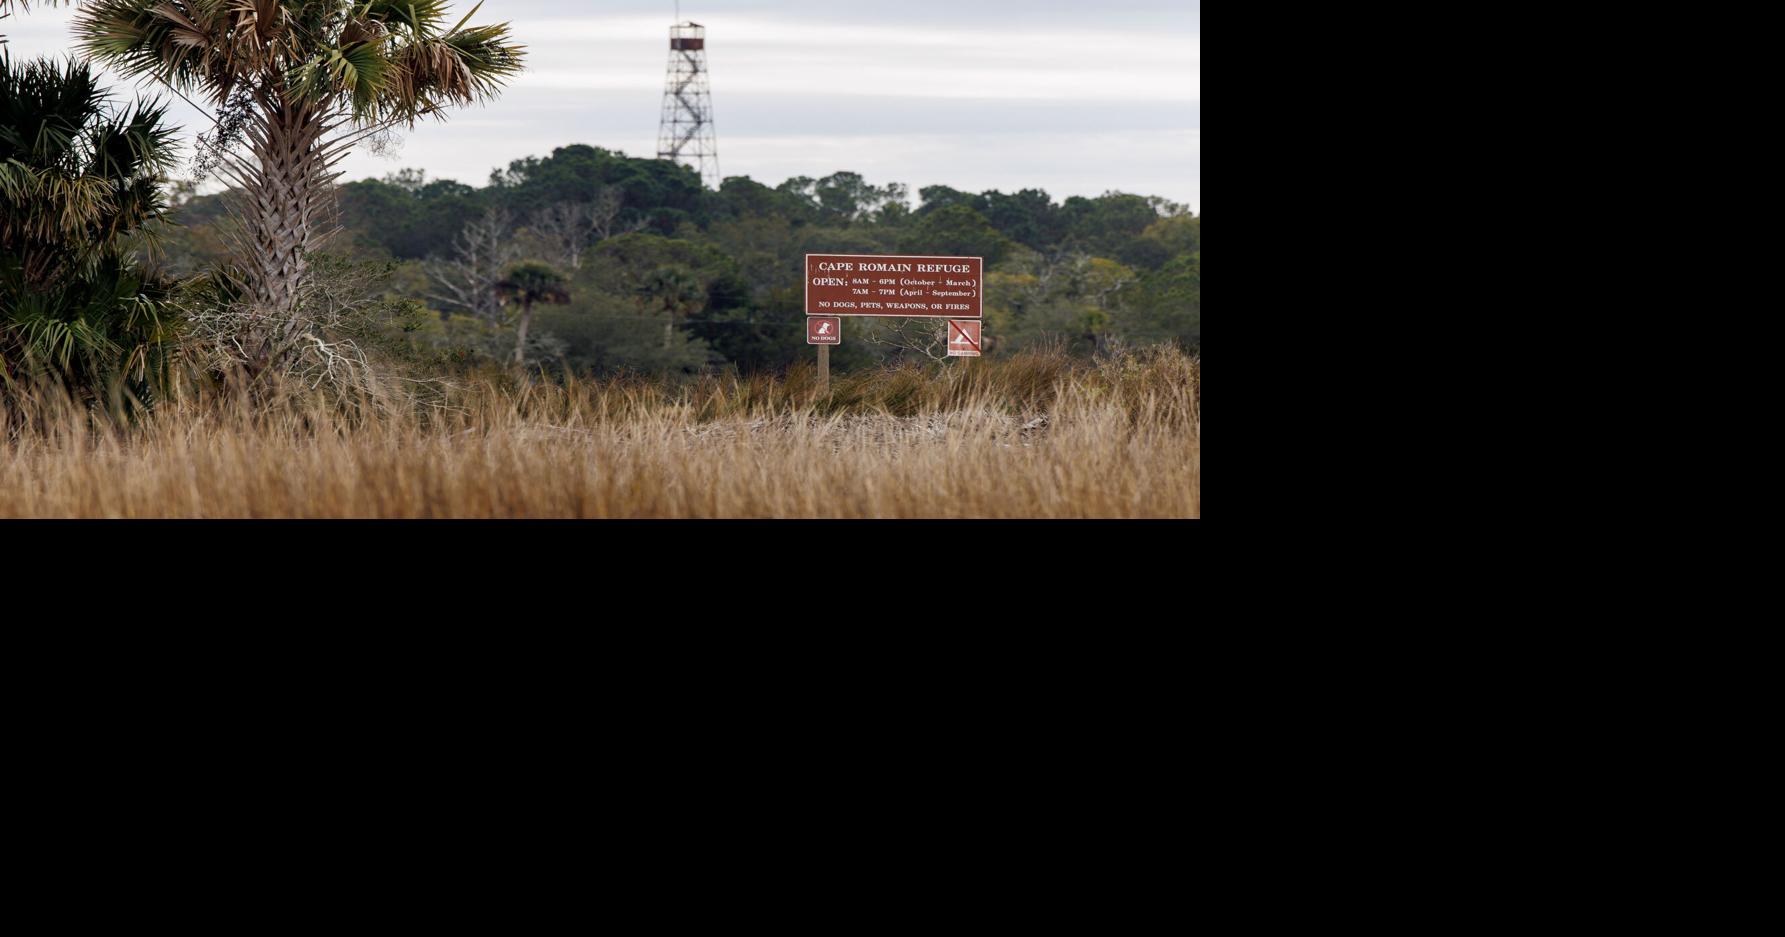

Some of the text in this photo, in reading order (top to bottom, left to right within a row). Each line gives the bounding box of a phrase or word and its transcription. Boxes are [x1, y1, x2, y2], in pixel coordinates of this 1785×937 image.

[819, 262, 970, 273] CAPE ROMAIN REFUGE
[812, 277, 848, 286] OPEN:
[900, 277, 935, 286] (October
[946, 278, 976, 287] March)
[900, 288, 923, 297] (April
[932, 289, 976, 298] September)
[833, 301, 858, 309] DOGS,
[860, 302, 883, 310] PETS,
[886, 302, 929, 310] WEAPONS,
